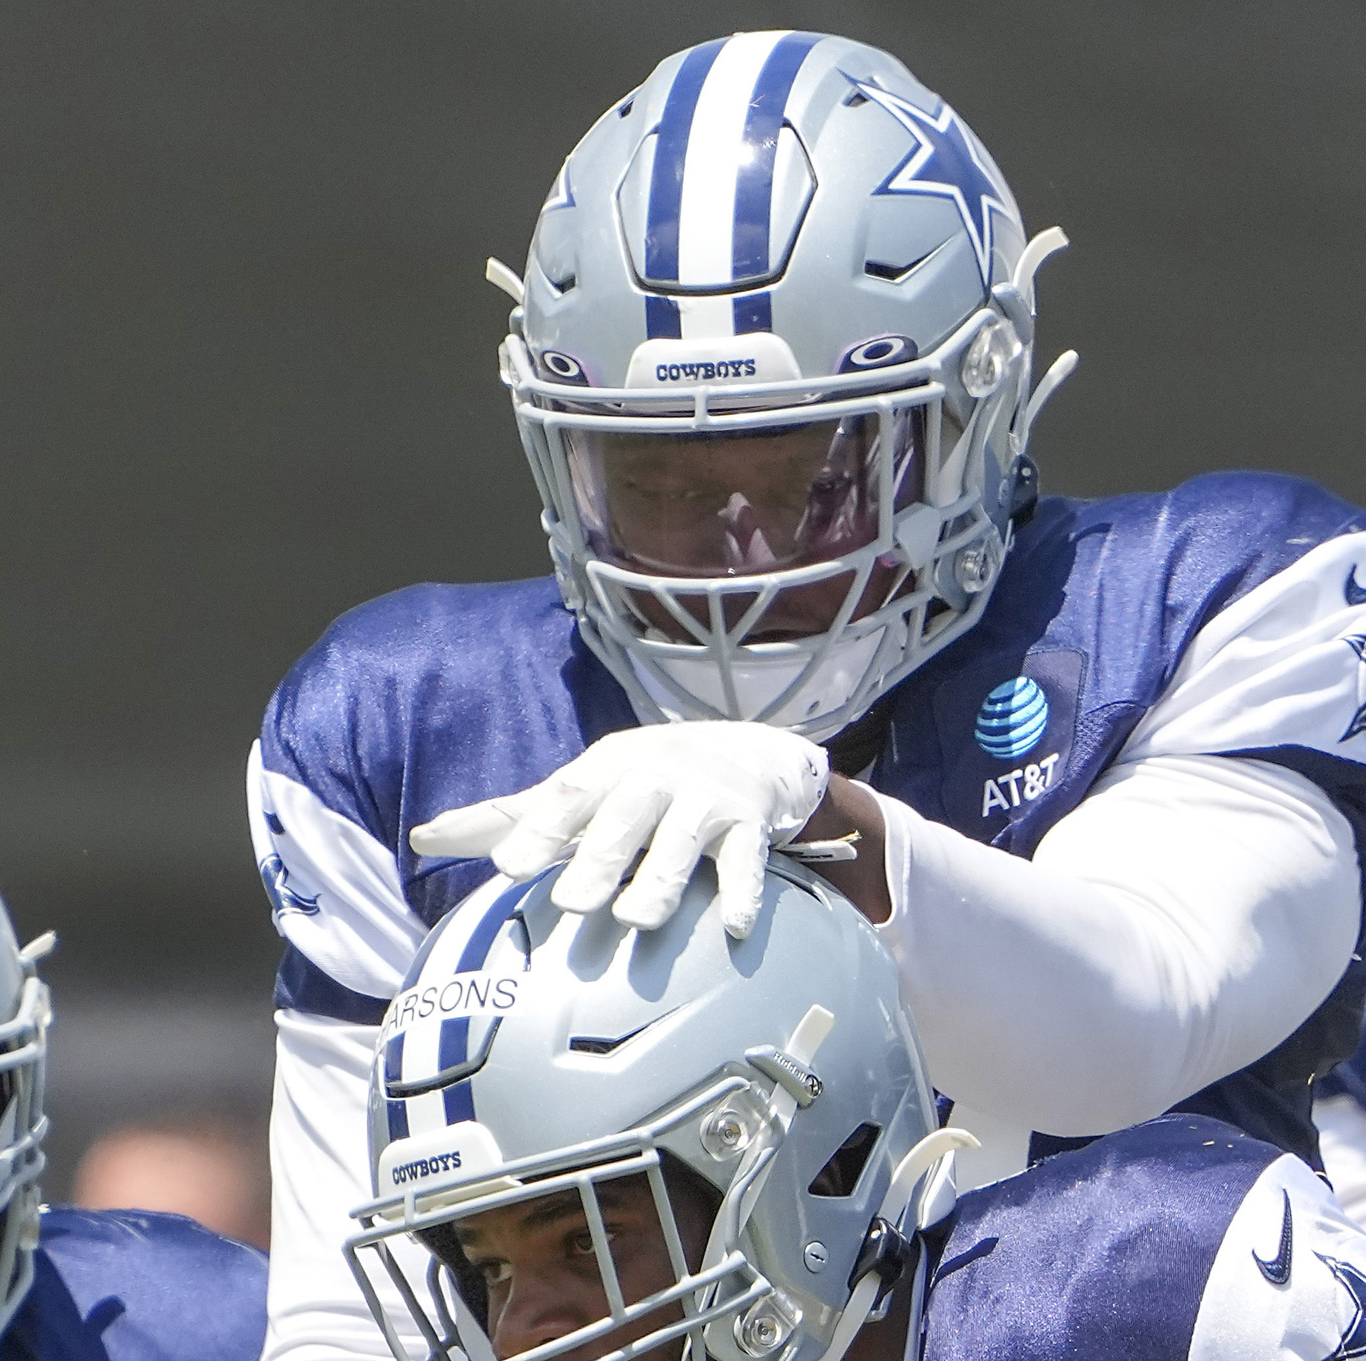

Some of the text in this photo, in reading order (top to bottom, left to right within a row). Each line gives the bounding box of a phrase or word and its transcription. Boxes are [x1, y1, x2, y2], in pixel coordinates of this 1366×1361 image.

[655, 358, 756, 382] COWBOYS
[981, 753, 1060, 818] AT&T
[381, 978, 519, 1034] ARSONS
[391, 1151, 463, 1186] COWBOYS
